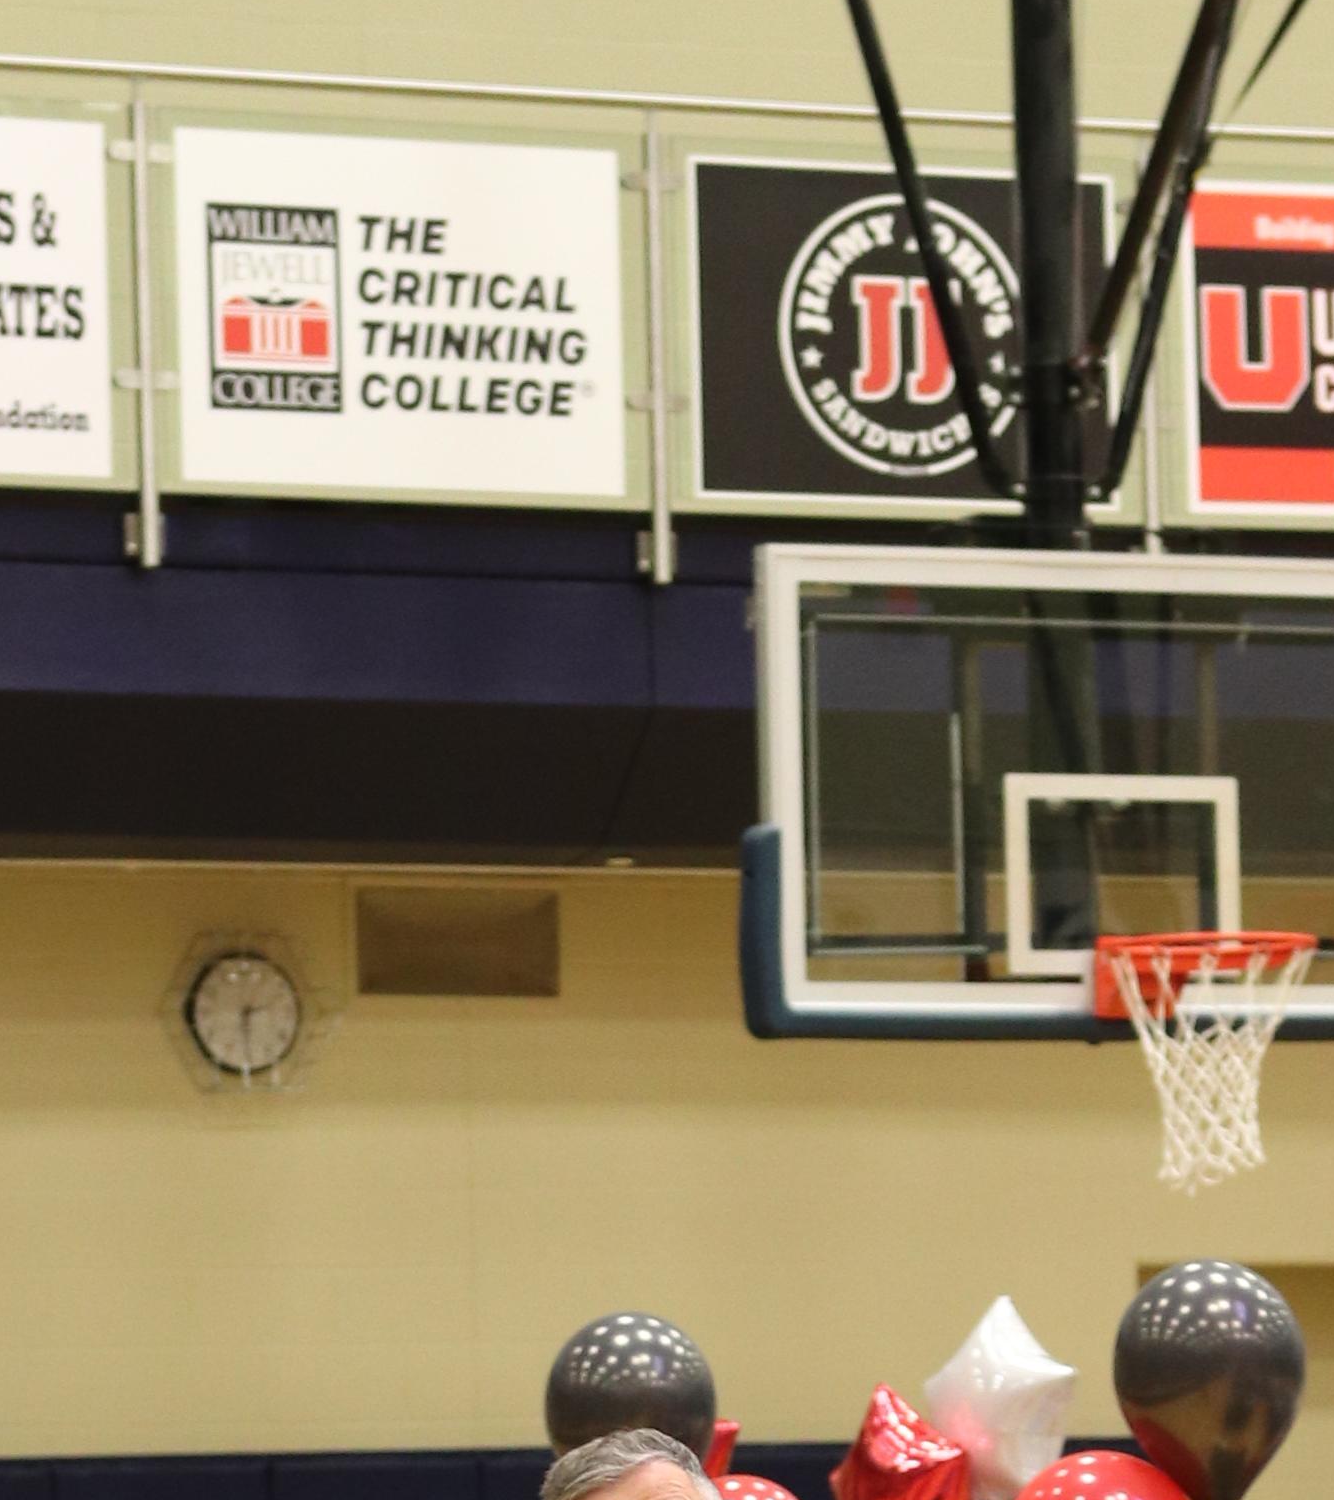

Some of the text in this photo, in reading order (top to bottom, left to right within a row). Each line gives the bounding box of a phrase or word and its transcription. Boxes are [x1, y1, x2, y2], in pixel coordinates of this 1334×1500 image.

[31, 193, 59, 247] &
[208, 206, 338, 244] WILLIAM
[357, 214, 449, 255] THE
[221, 250, 330, 286] JEWELL
[357, 268, 577, 313] CRITICAL
[795, 214, 895, 334] JIMMY
[359, 321, 589, 366] THINKING
[1200, 283, 1312, 412] U
[212, 371, 343, 409] COLLEGE
